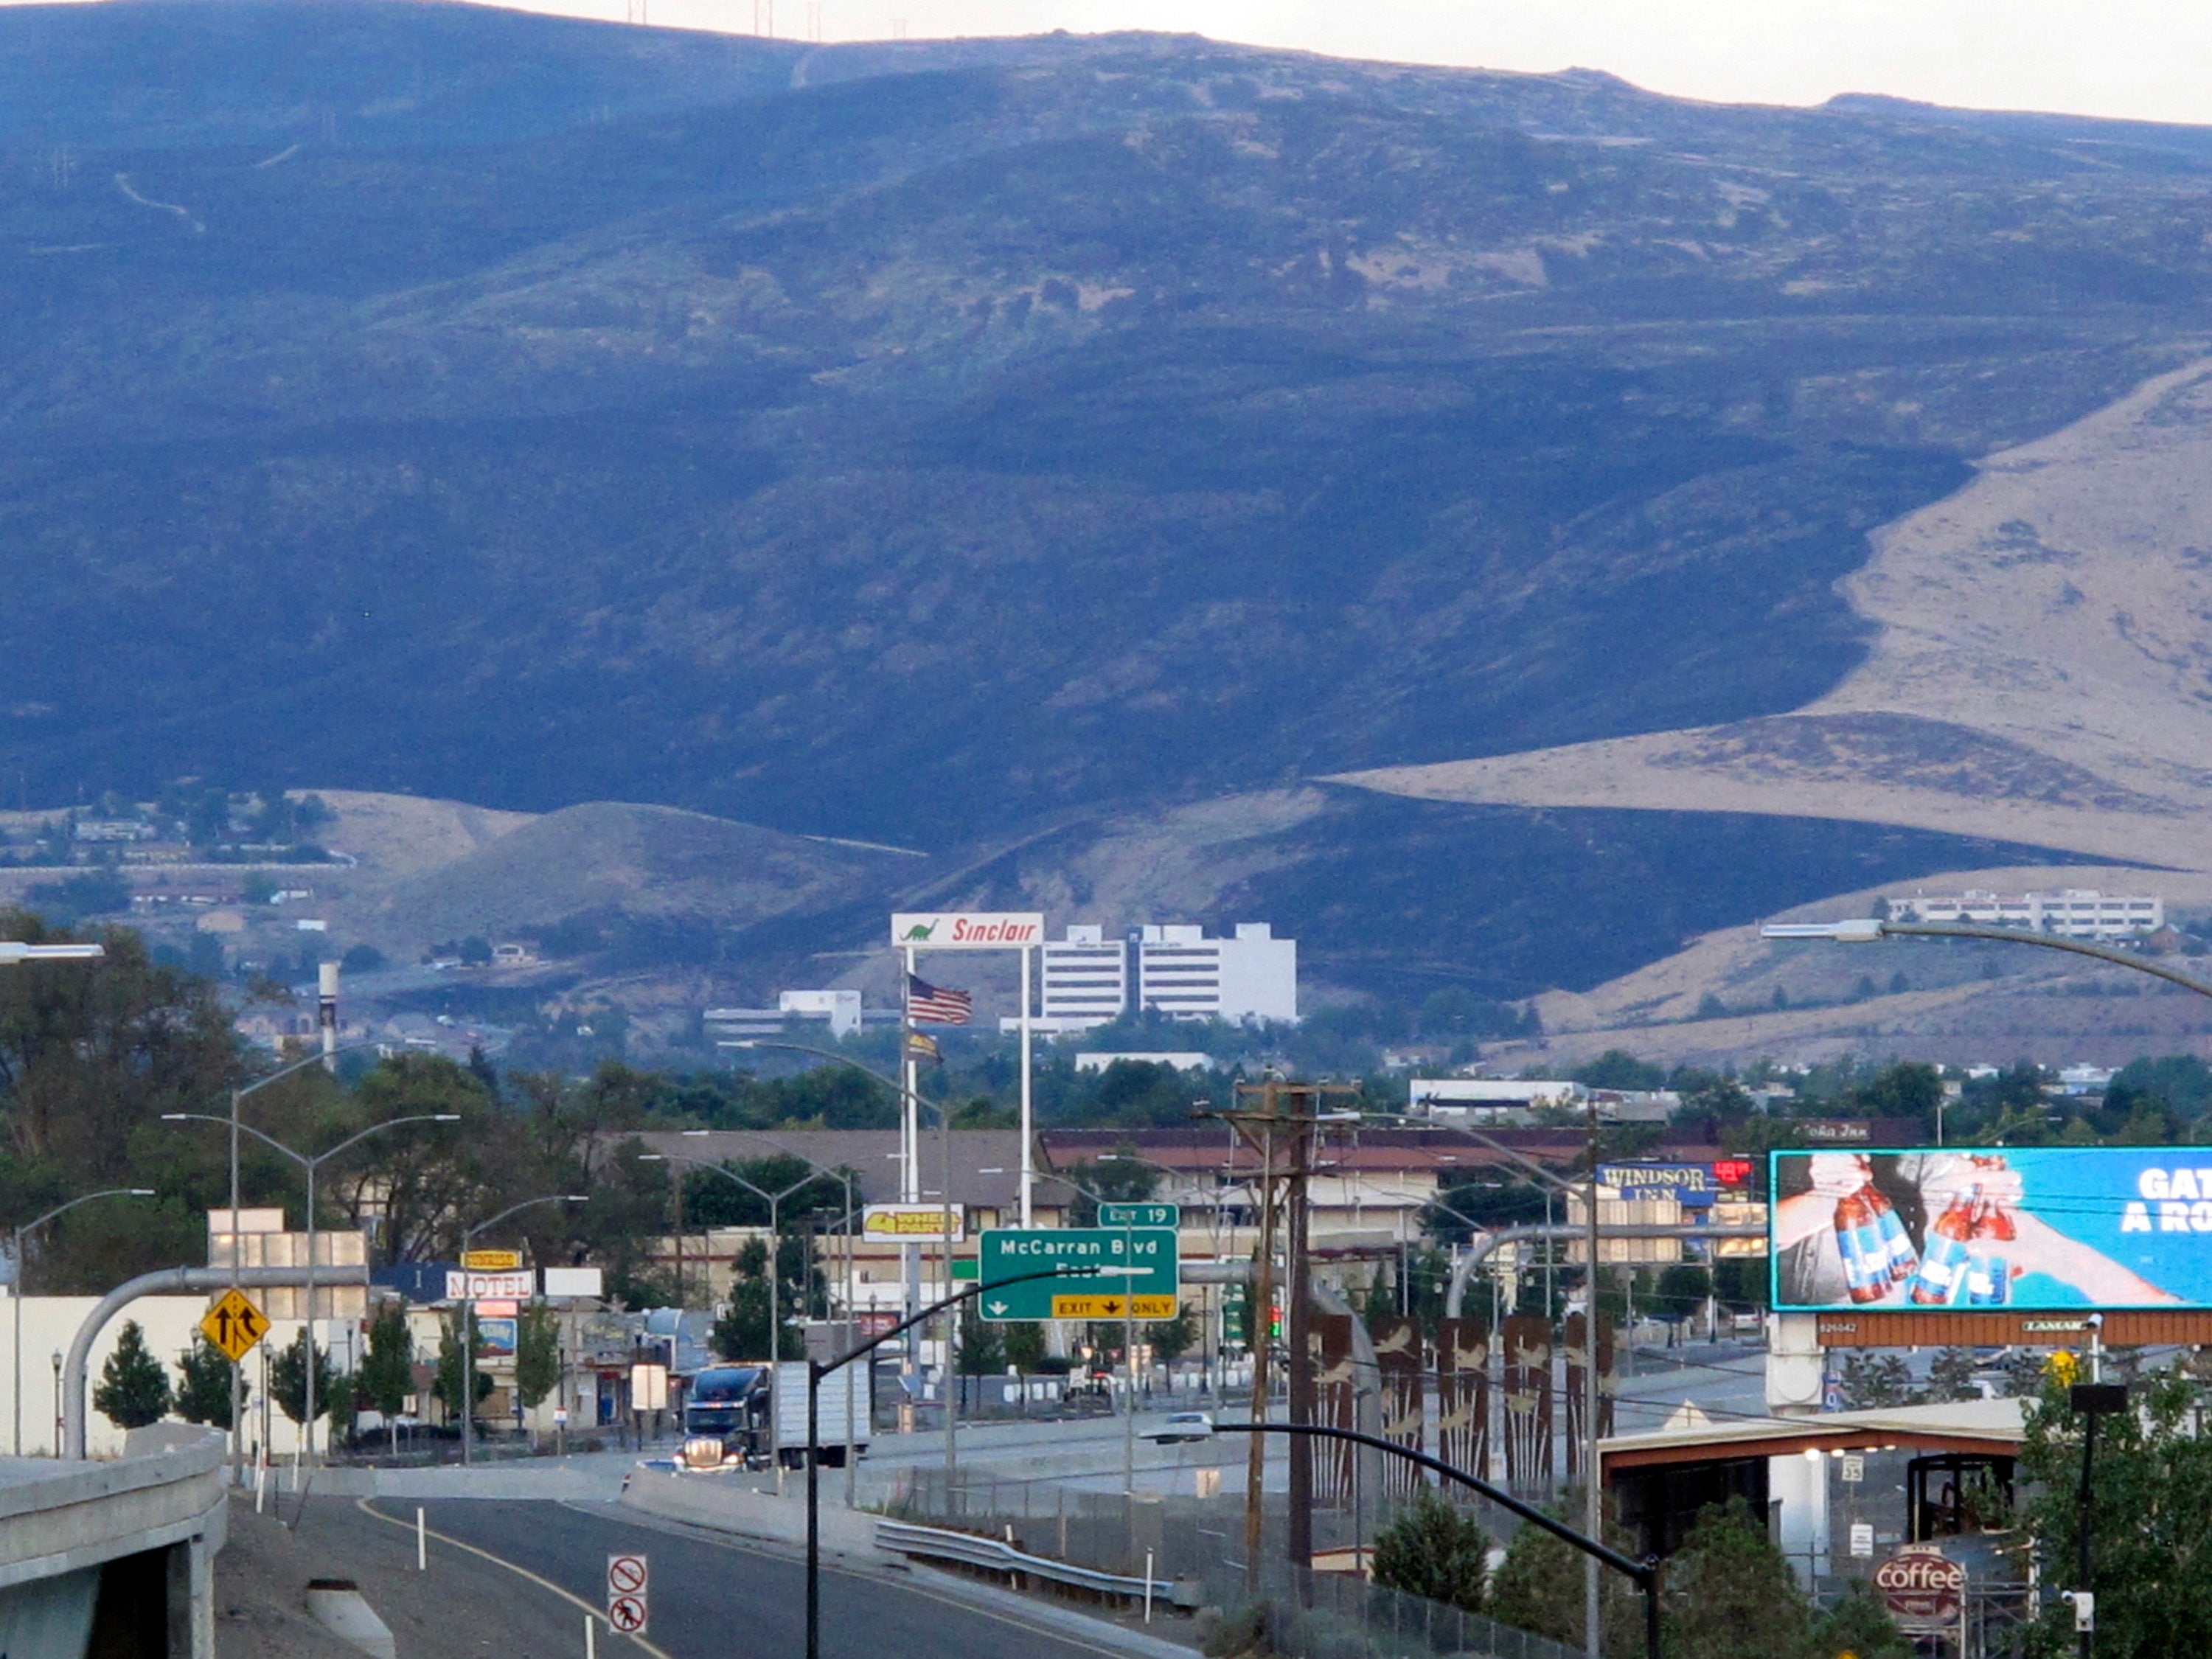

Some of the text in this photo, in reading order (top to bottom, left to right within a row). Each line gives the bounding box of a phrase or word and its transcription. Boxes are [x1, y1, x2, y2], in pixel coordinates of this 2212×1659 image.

[953, 918, 1036, 941] Sinclair
[1603, 1168, 1705, 1192] WINDSOR
[1634, 1188, 1677, 1200] INN
[1109, 1208, 1167, 1222] EXT 19
[2121, 1201, 2152, 1232] A
[1000, 1239, 1158, 1254] McCarran Bvd
[449, 1276, 529, 1297] MOTEL
[1059, 1302, 1171, 1313] EXIT ONLY
[1877, 1562, 1964, 1590] coffee
